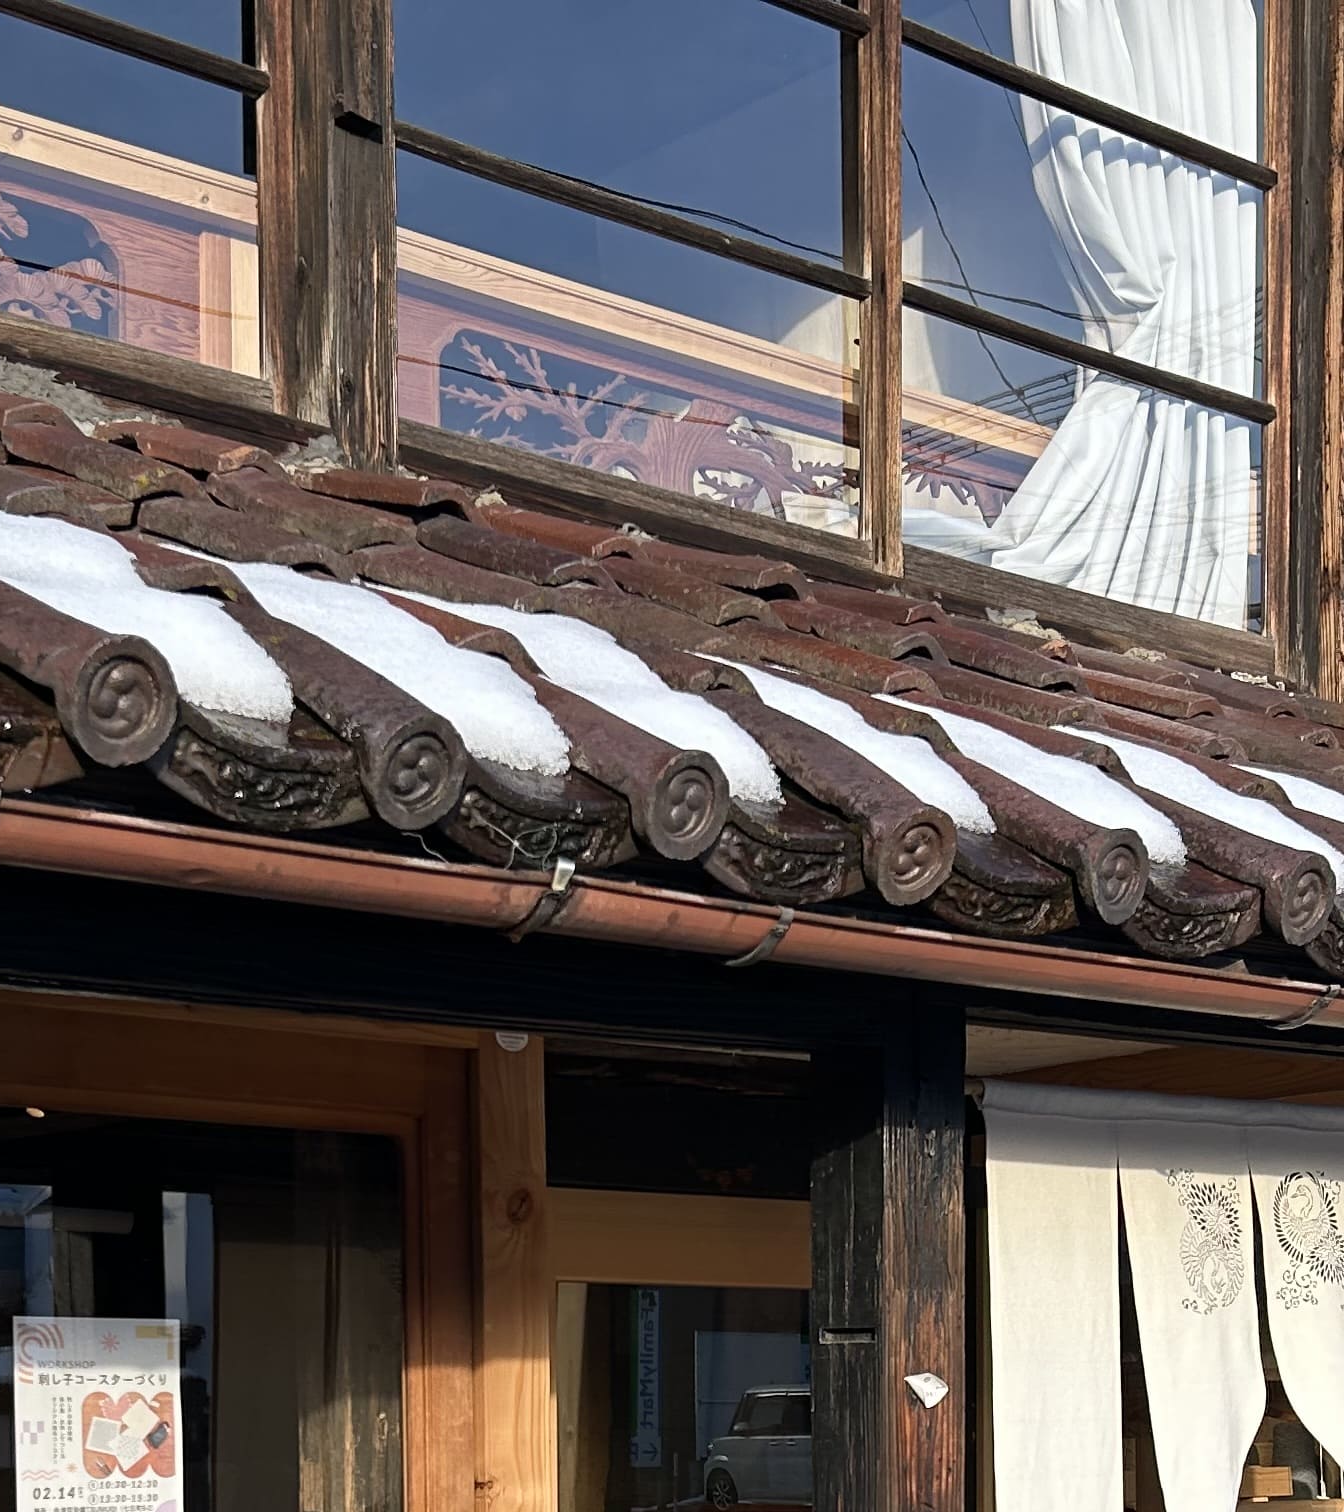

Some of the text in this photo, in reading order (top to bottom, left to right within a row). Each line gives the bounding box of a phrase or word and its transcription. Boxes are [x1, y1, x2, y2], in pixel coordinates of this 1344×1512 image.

[37, 1360, 96, 1369] WORKSHOP
[38, 1373, 168, 1386] 刺し子コースターづくり
[32, 1486, 75, 1500] 02.14
